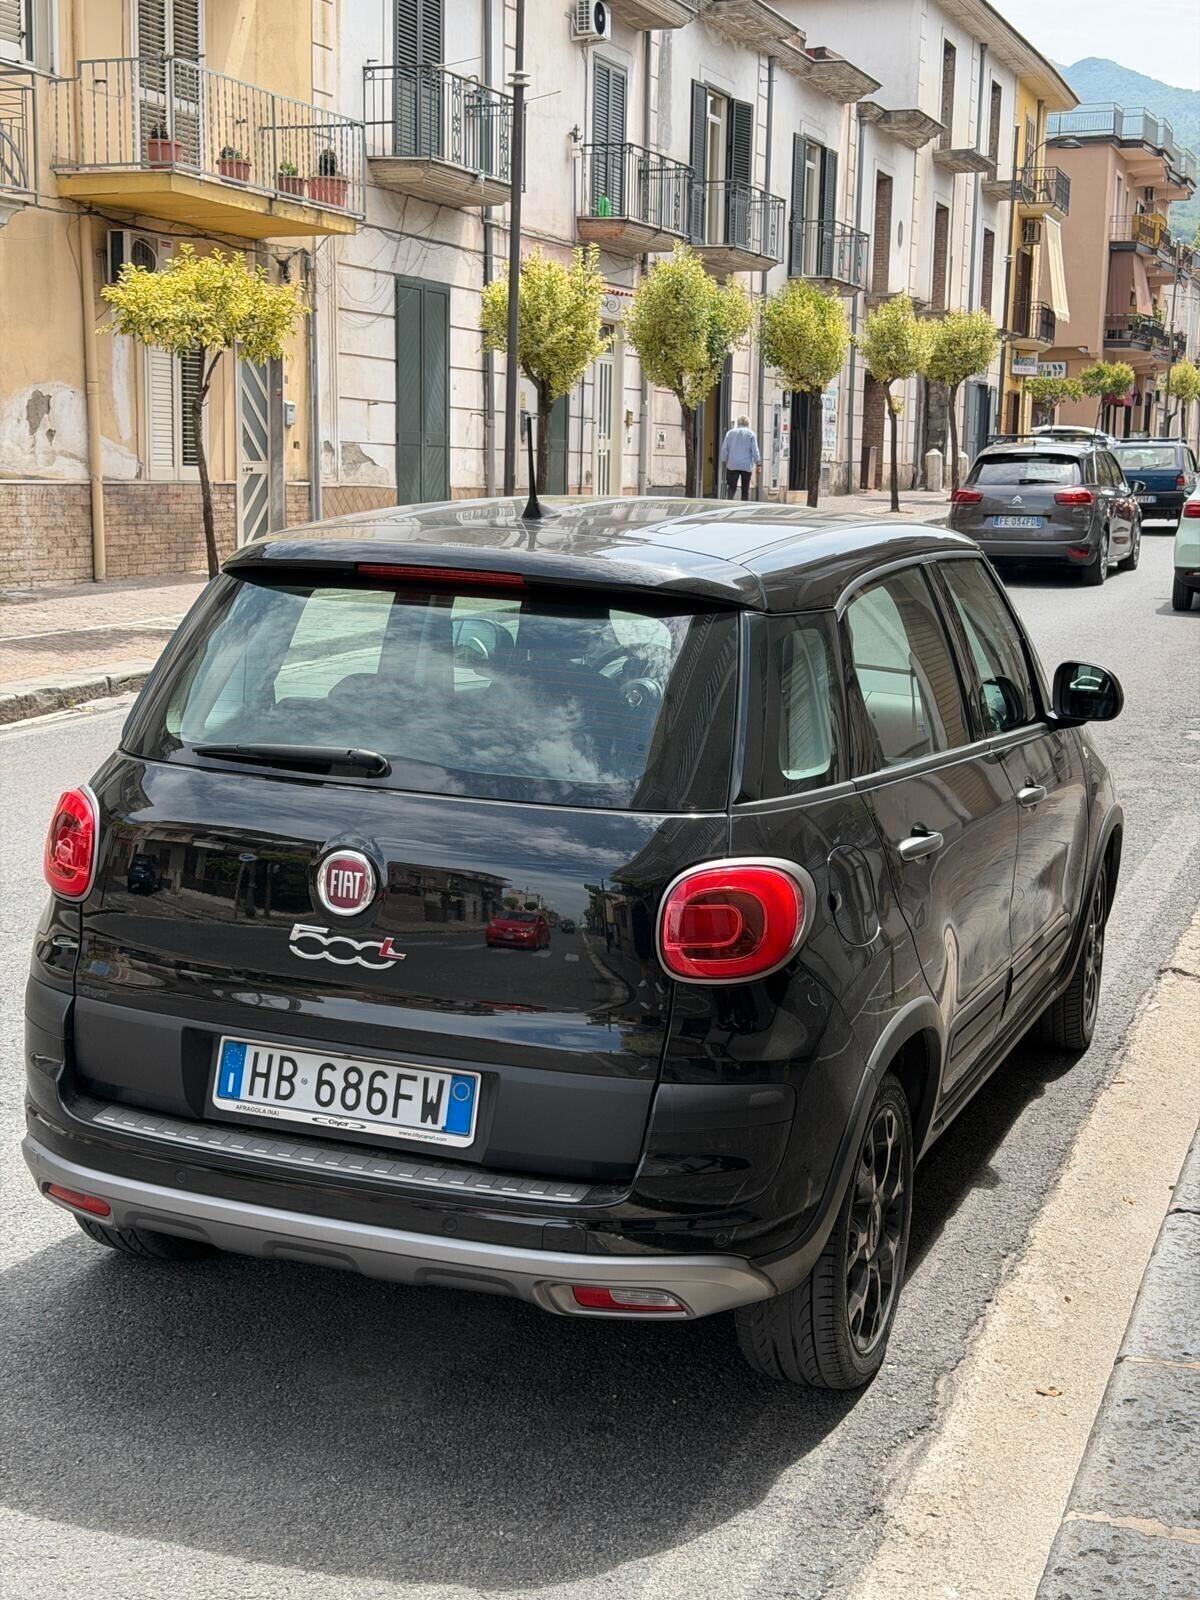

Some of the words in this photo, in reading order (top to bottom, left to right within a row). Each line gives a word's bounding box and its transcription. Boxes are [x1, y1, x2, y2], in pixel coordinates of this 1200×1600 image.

[329, 869, 364, 900] FIAT
[288, 923, 407, 970] 500L
[248, 1051, 298, 1101] HB
[314, 1062, 445, 1125] 686FW
[235, 1104, 267, 1116] AFRAGOLA
[328, 1118, 350, 1127] Citycar
